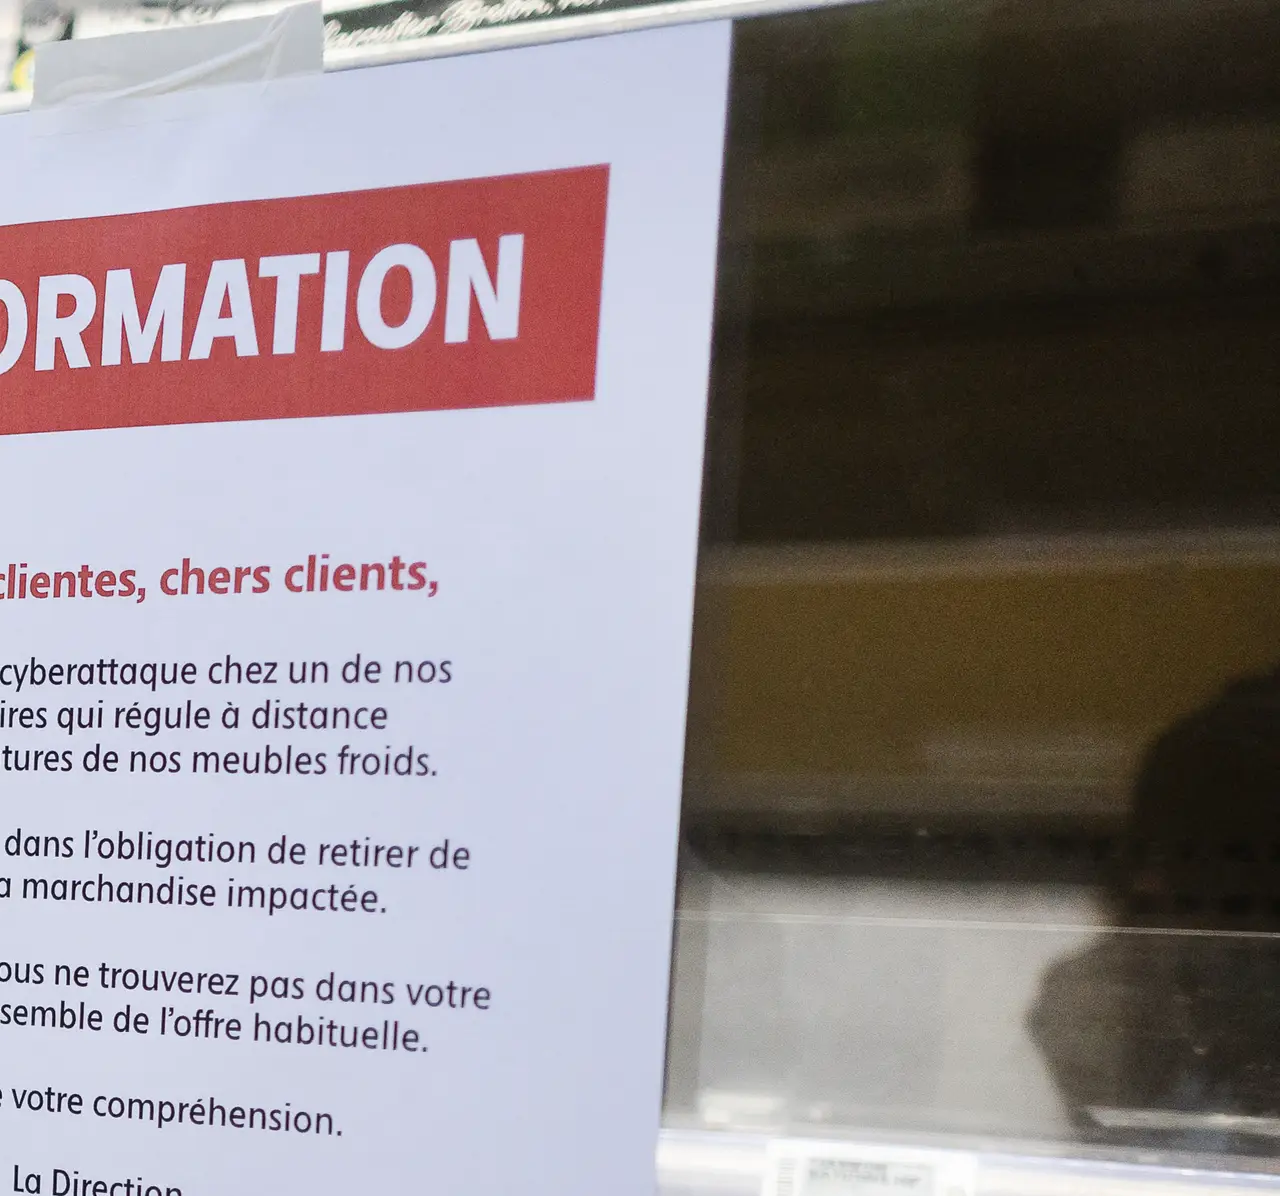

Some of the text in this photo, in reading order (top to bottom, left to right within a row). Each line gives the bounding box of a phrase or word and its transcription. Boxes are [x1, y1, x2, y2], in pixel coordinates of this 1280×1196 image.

[159, 557, 271, 596] chers
[283, 553, 439, 598] clients,
[208, 654, 278, 685] chez
[288, 660, 329, 685] un
[341, 652, 382, 684] de
[394, 659, 453, 684] nos
[56, 699, 104, 736] qui
[114, 699, 211, 737] régule
[221, 701, 240, 730] à
[251, 698, 389, 730] distance
[82, 742, 119, 773] de
[129, 750, 182, 774] nos
[192, 744, 328, 776] meubles
[337, 744, 438, 777] froids.
[4, 827, 74, 859] dans
[84, 829, 256, 869] l’obligation
[267, 834, 307, 866] de
[318, 836, 421, 869] retirer
[429, 838, 471, 871] de
[22, 873, 217, 907] marchandise
[227, 877, 387, 917] impactée.
[54, 964, 90, 988] ne
[97, 962, 240, 996] trouverez
[249, 975, 305, 1005] pas
[315, 971, 396, 1005] dans
[405, 980, 492, 1011] votre
[112, 1003, 150, 1035] de
[160, 1006, 242, 1041] l’offre
[253, 1011, 429, 1053] habituelle.
[11, 1086, 84, 1115] votre
[92, 1095, 343, 1137] compréhension.
[13, 1164, 42, 1195] La
